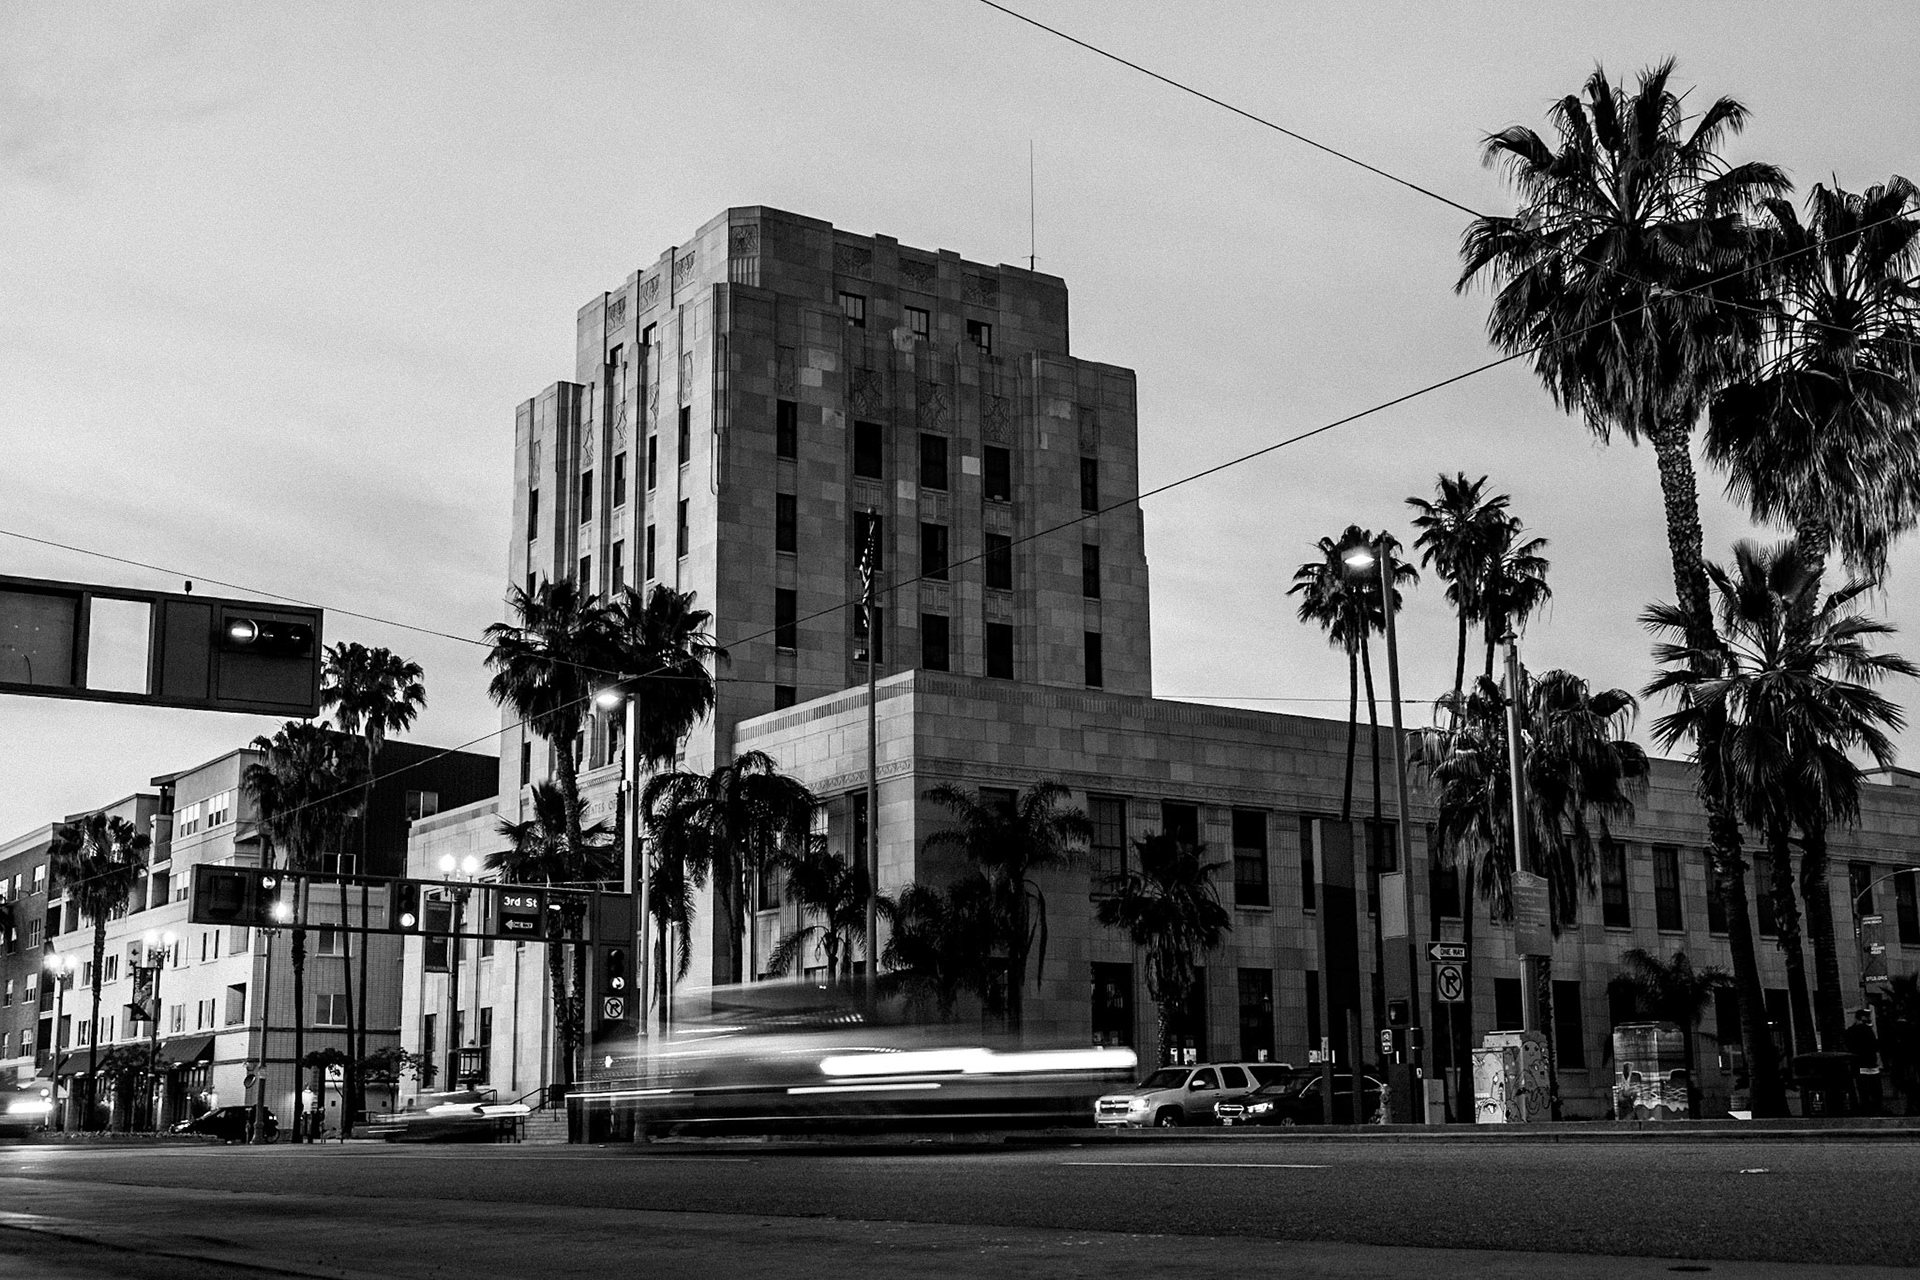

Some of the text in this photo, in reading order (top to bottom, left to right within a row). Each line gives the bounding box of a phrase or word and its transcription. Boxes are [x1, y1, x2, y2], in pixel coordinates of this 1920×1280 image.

[503, 896, 538, 908] 3rd St
[1440, 948, 1464, 956] ONE WAY
